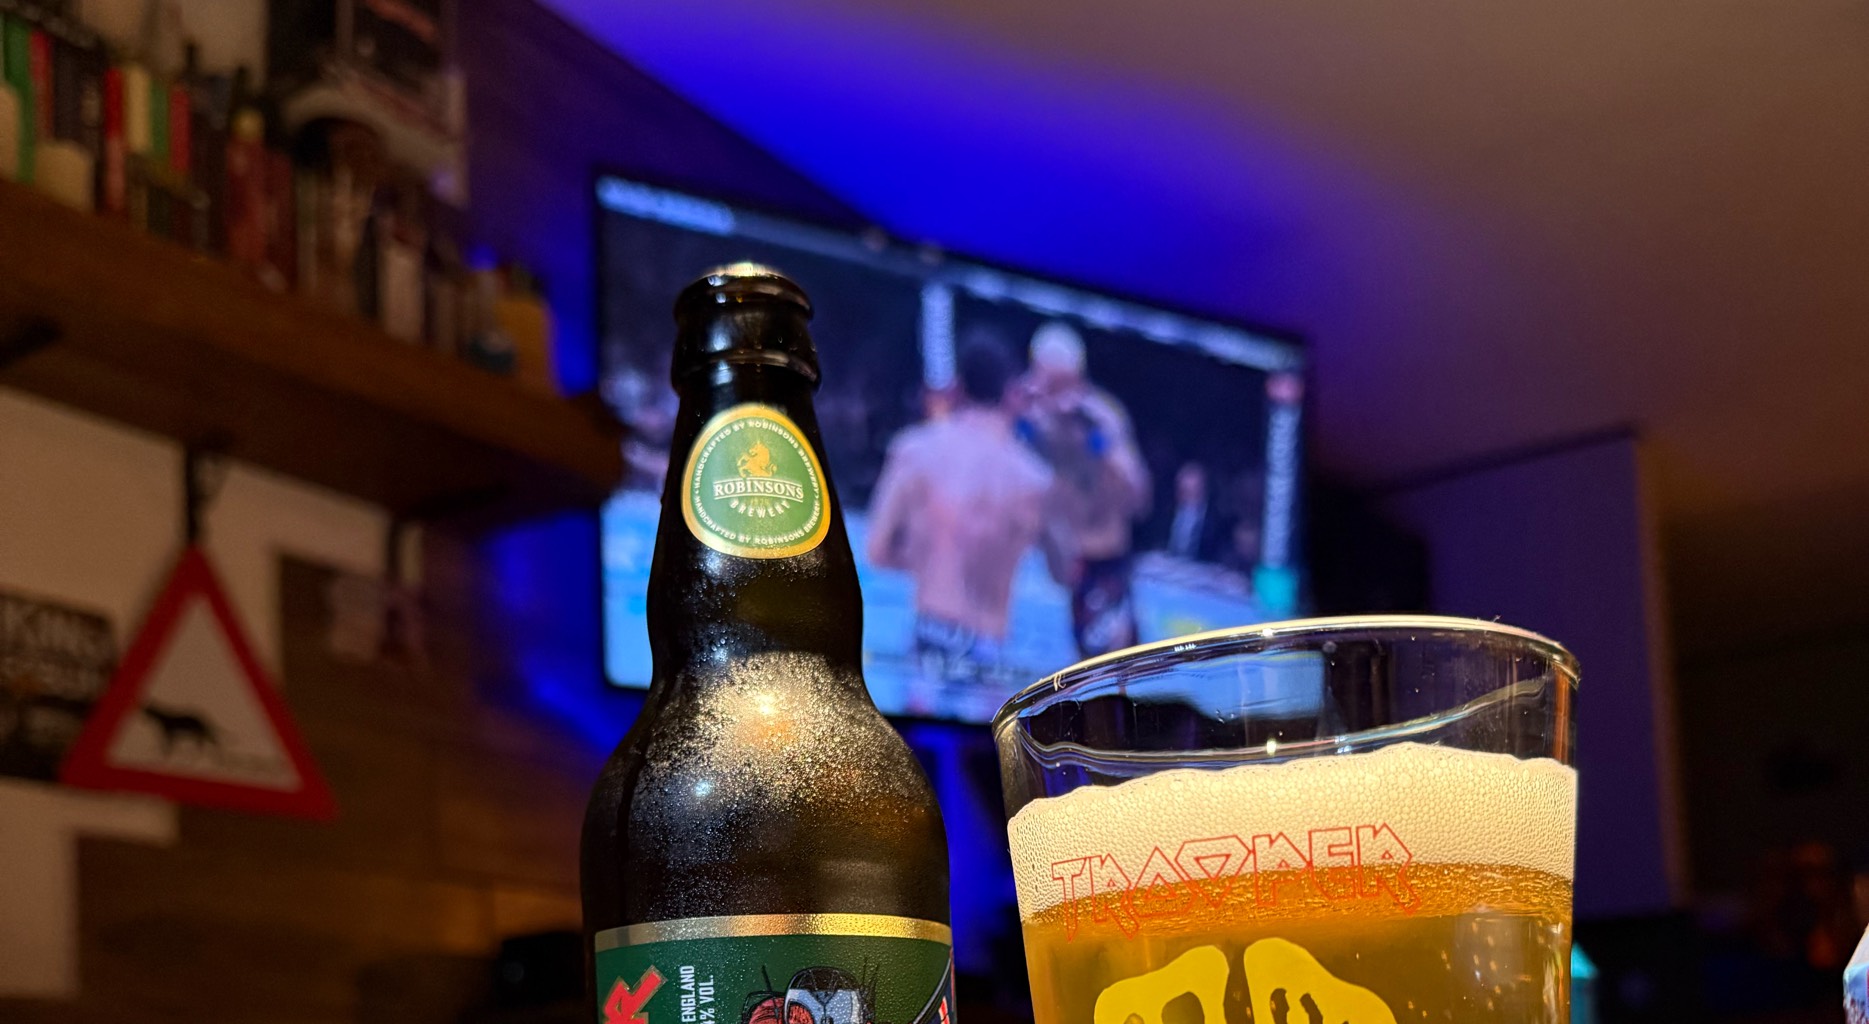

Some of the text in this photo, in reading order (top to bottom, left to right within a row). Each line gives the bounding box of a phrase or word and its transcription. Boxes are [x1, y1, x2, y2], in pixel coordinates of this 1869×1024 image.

[694, 429, 732, 489] HANDCRAFTED
[732, 420, 746, 433] BY
[747, 420, 799, 450] ROBINSONS
[713, 479, 804, 500] ROBINSONS
[729, 498, 791, 519] BREWERY
[694, 496, 737, 541] HANDCRAFTED
[753, 530, 805, 546] ROBINSONS
[803, 501, 821, 534] BREWERY
[1051, 822, 1422, 943] TROOPER
[680, 965, 697, 1022] ENGLAND
[699, 974, 715, 1004] VOL.
